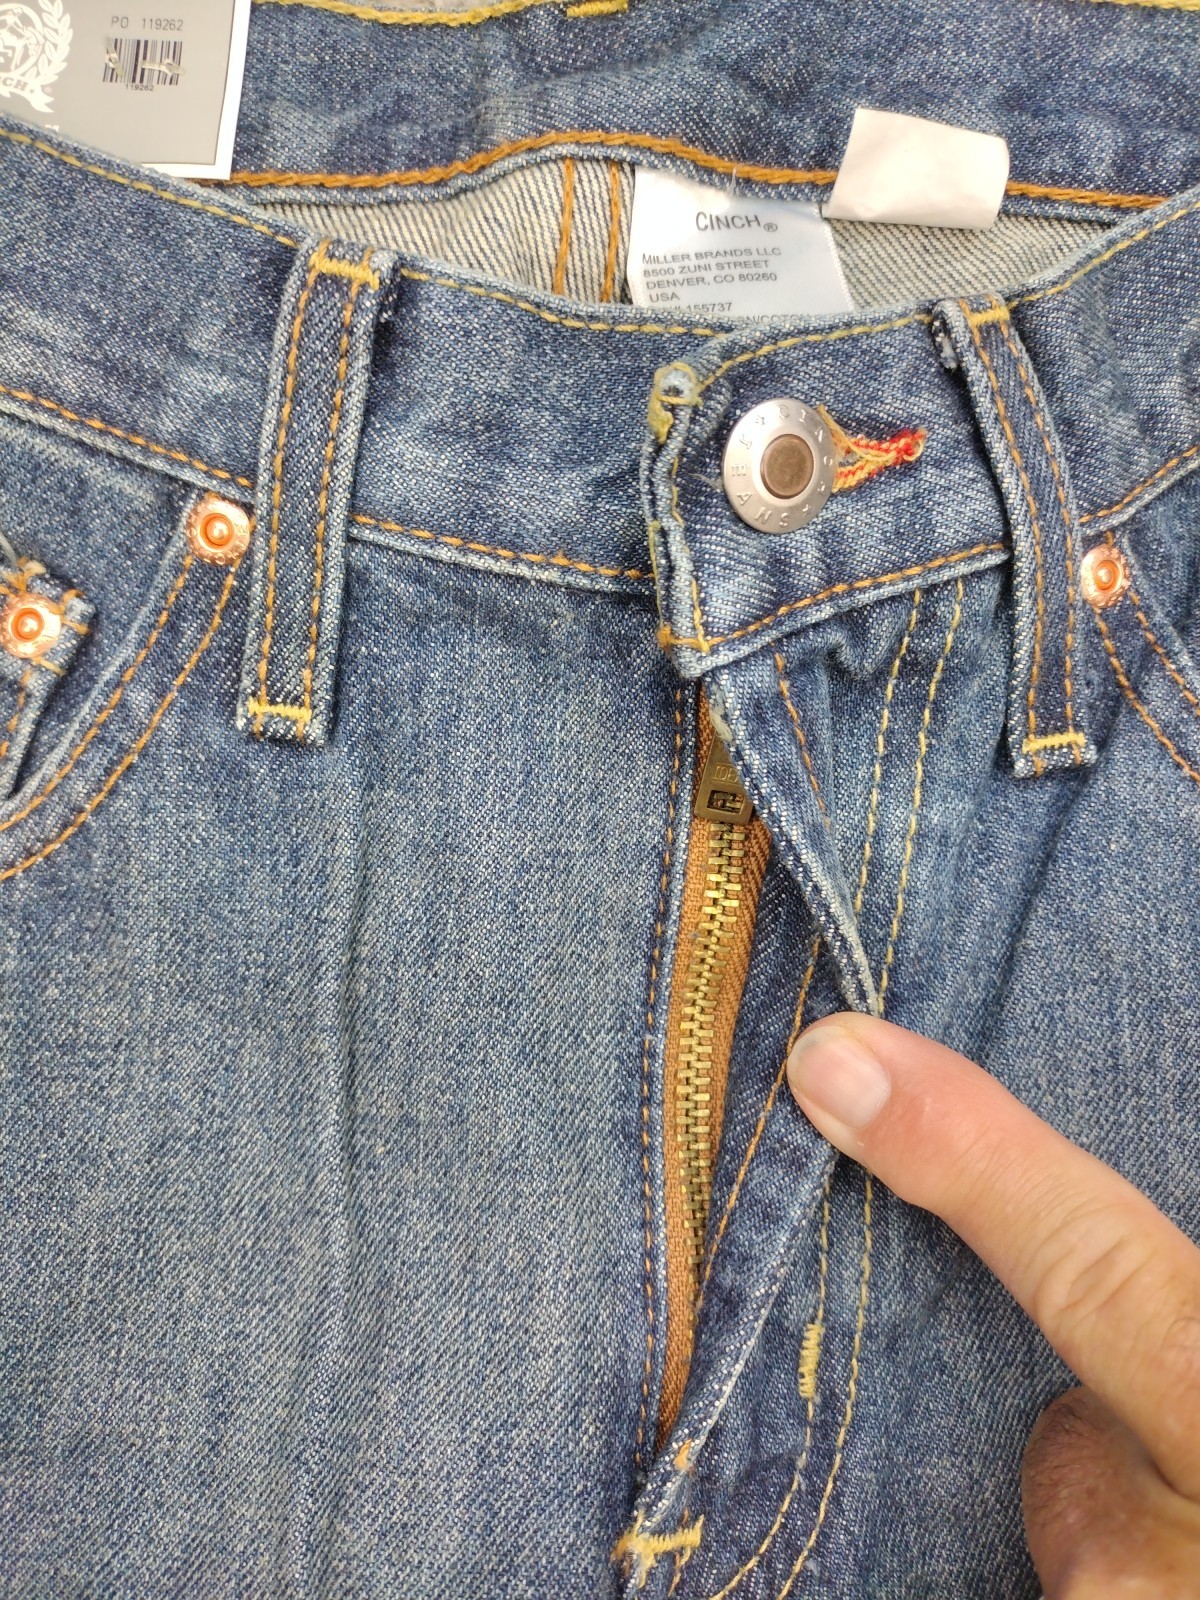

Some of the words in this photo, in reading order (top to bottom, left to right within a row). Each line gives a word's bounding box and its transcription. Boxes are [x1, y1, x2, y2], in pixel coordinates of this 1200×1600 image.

[111, 16, 129, 28] PO
[142, 18, 184, 32] 119262
[0, 76, 28, 92] CH
[125, 83, 155, 92] 119262
[642, 253, 692, 265] MILLER
[694, 248, 753, 261] BRANDS
[756, 247, 782, 257] LLC
[643, 267, 675, 278] 8500
[678, 263, 712, 275] ZUNI
[715, 259, 770, 271] STREET
[646, 276, 711, 290] DENVER,
[713, 273, 735, 284] CO
[649, 291, 680, 303] USA
[687, 301, 732, 313] 155737
